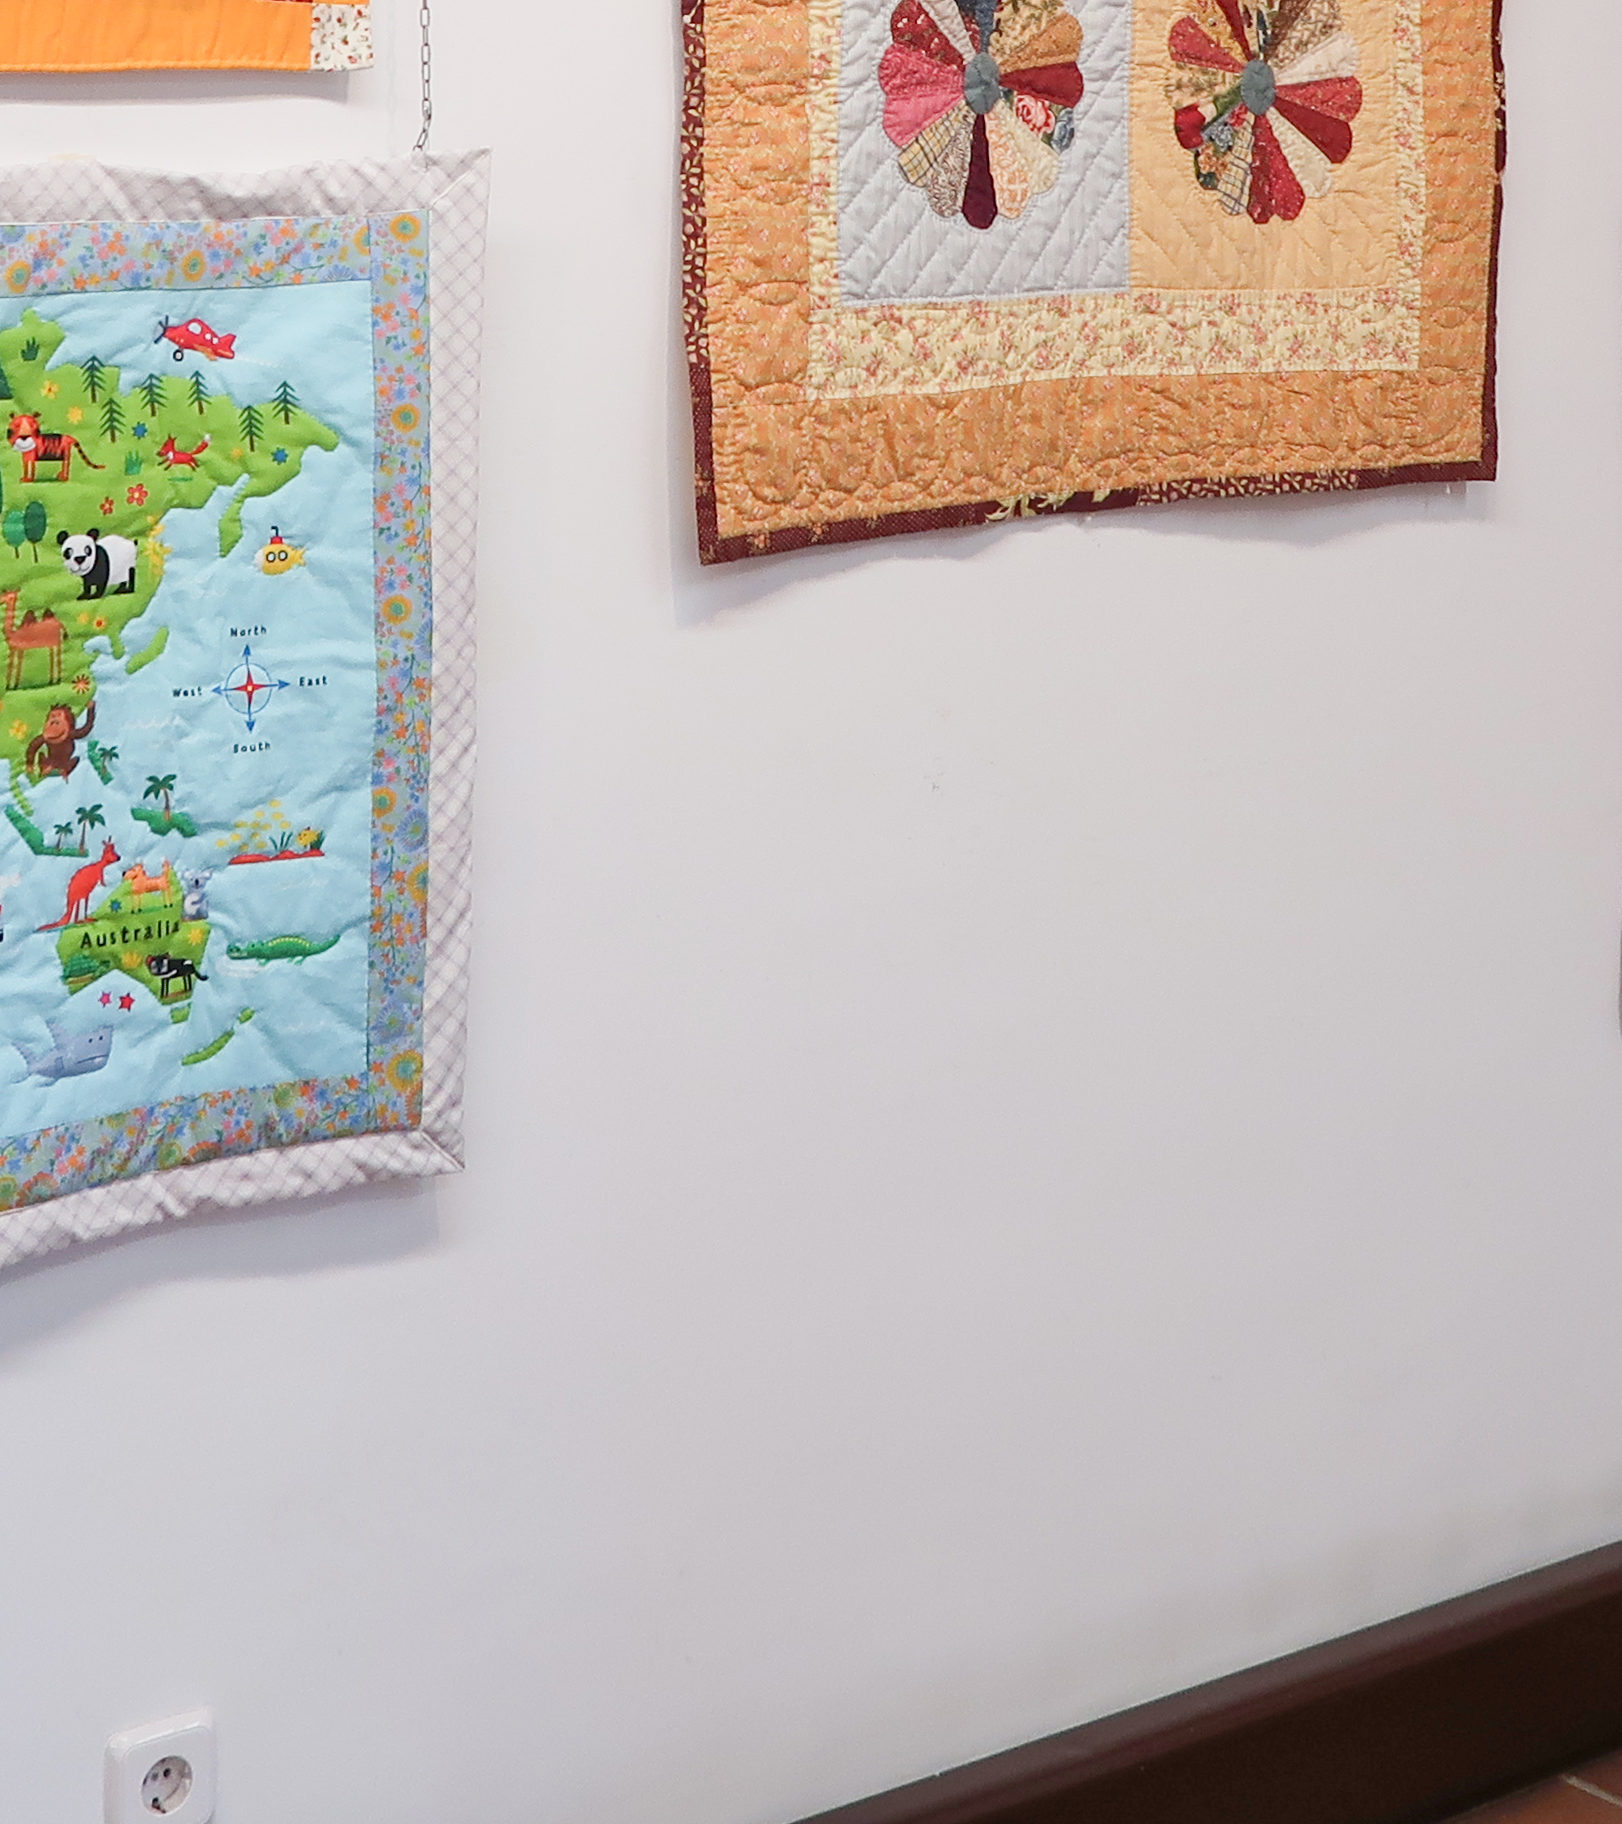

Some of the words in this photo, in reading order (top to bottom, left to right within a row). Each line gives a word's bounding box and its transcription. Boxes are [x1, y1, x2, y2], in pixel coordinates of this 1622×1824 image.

[230, 625, 267, 637] North
[299, 676, 328, 687] East
[172, 686, 202, 697] West
[233, 741, 271, 753] South
[80, 920, 180, 949] Australia
